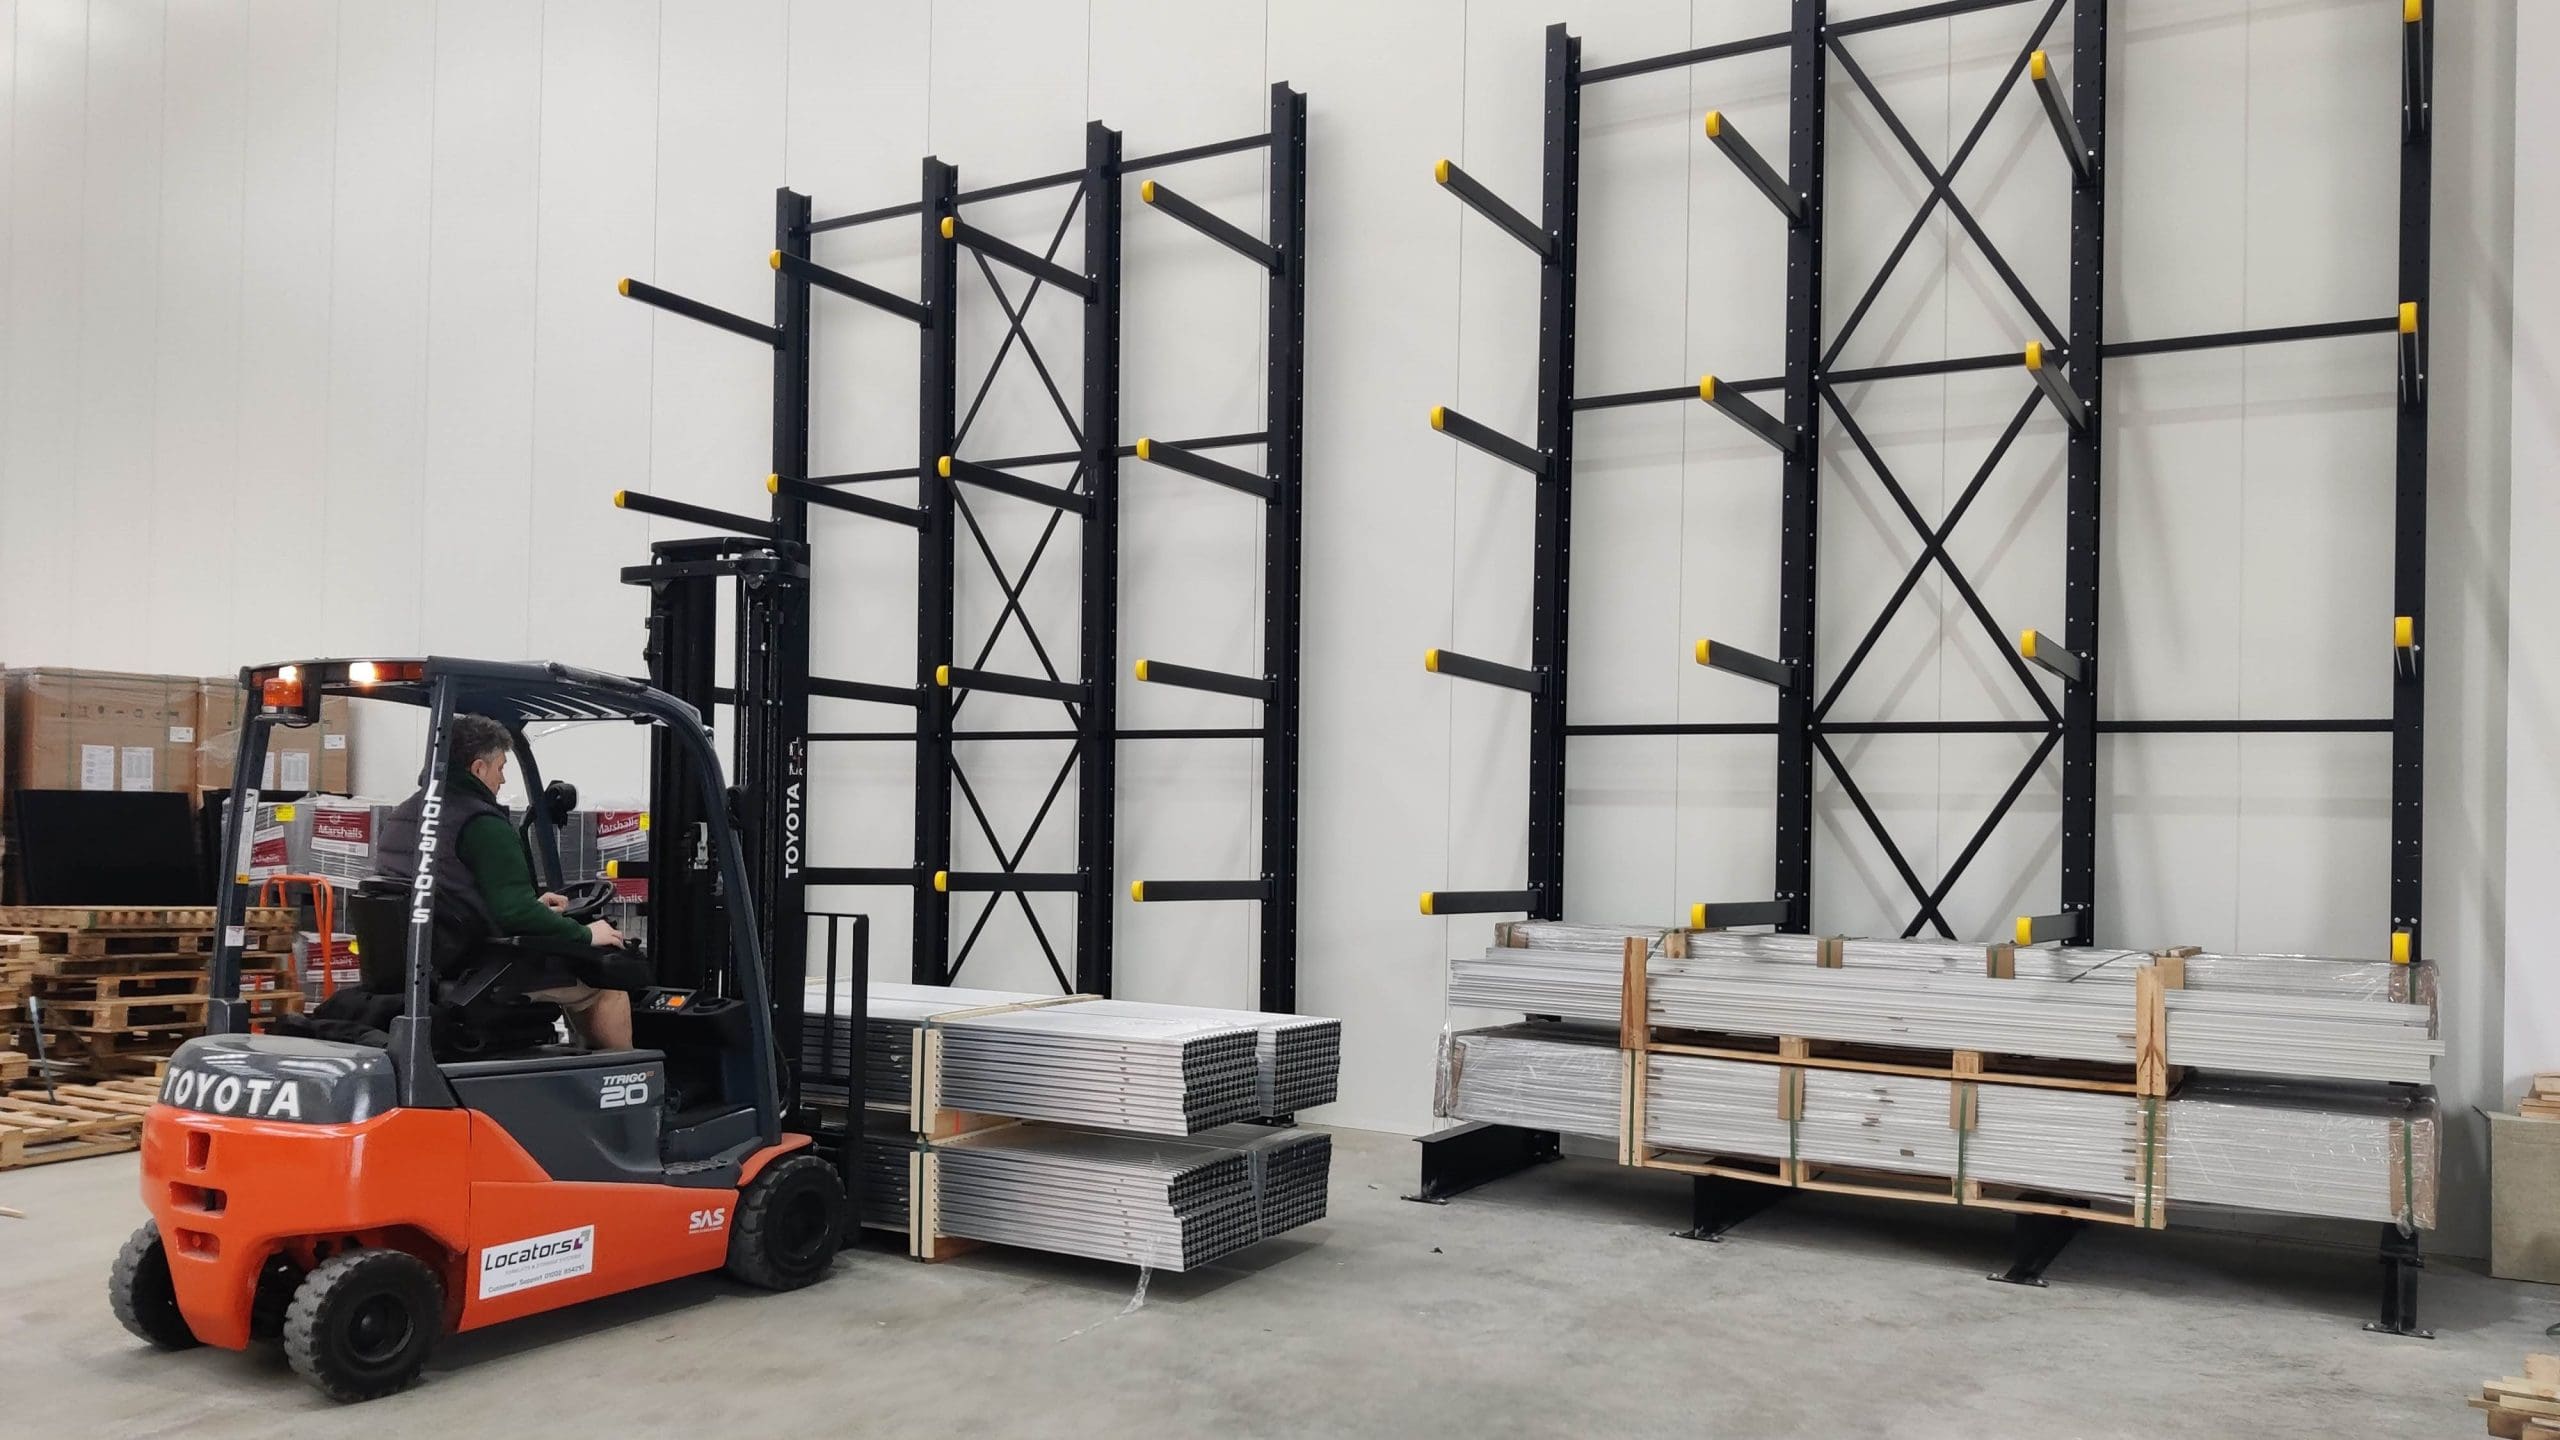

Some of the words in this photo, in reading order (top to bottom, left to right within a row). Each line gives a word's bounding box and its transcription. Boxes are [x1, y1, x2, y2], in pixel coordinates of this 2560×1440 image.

[318, 824, 363, 840] Marshalls
[785, 782, 800, 879] TOYOTA
[411, 779, 442, 924] Locators
[163, 1066, 301, 1118] TOYOTA
[600, 1083, 648, 1109] 20
[689, 1207, 726, 1229] SAS
[484, 1238, 573, 1271] Locators
